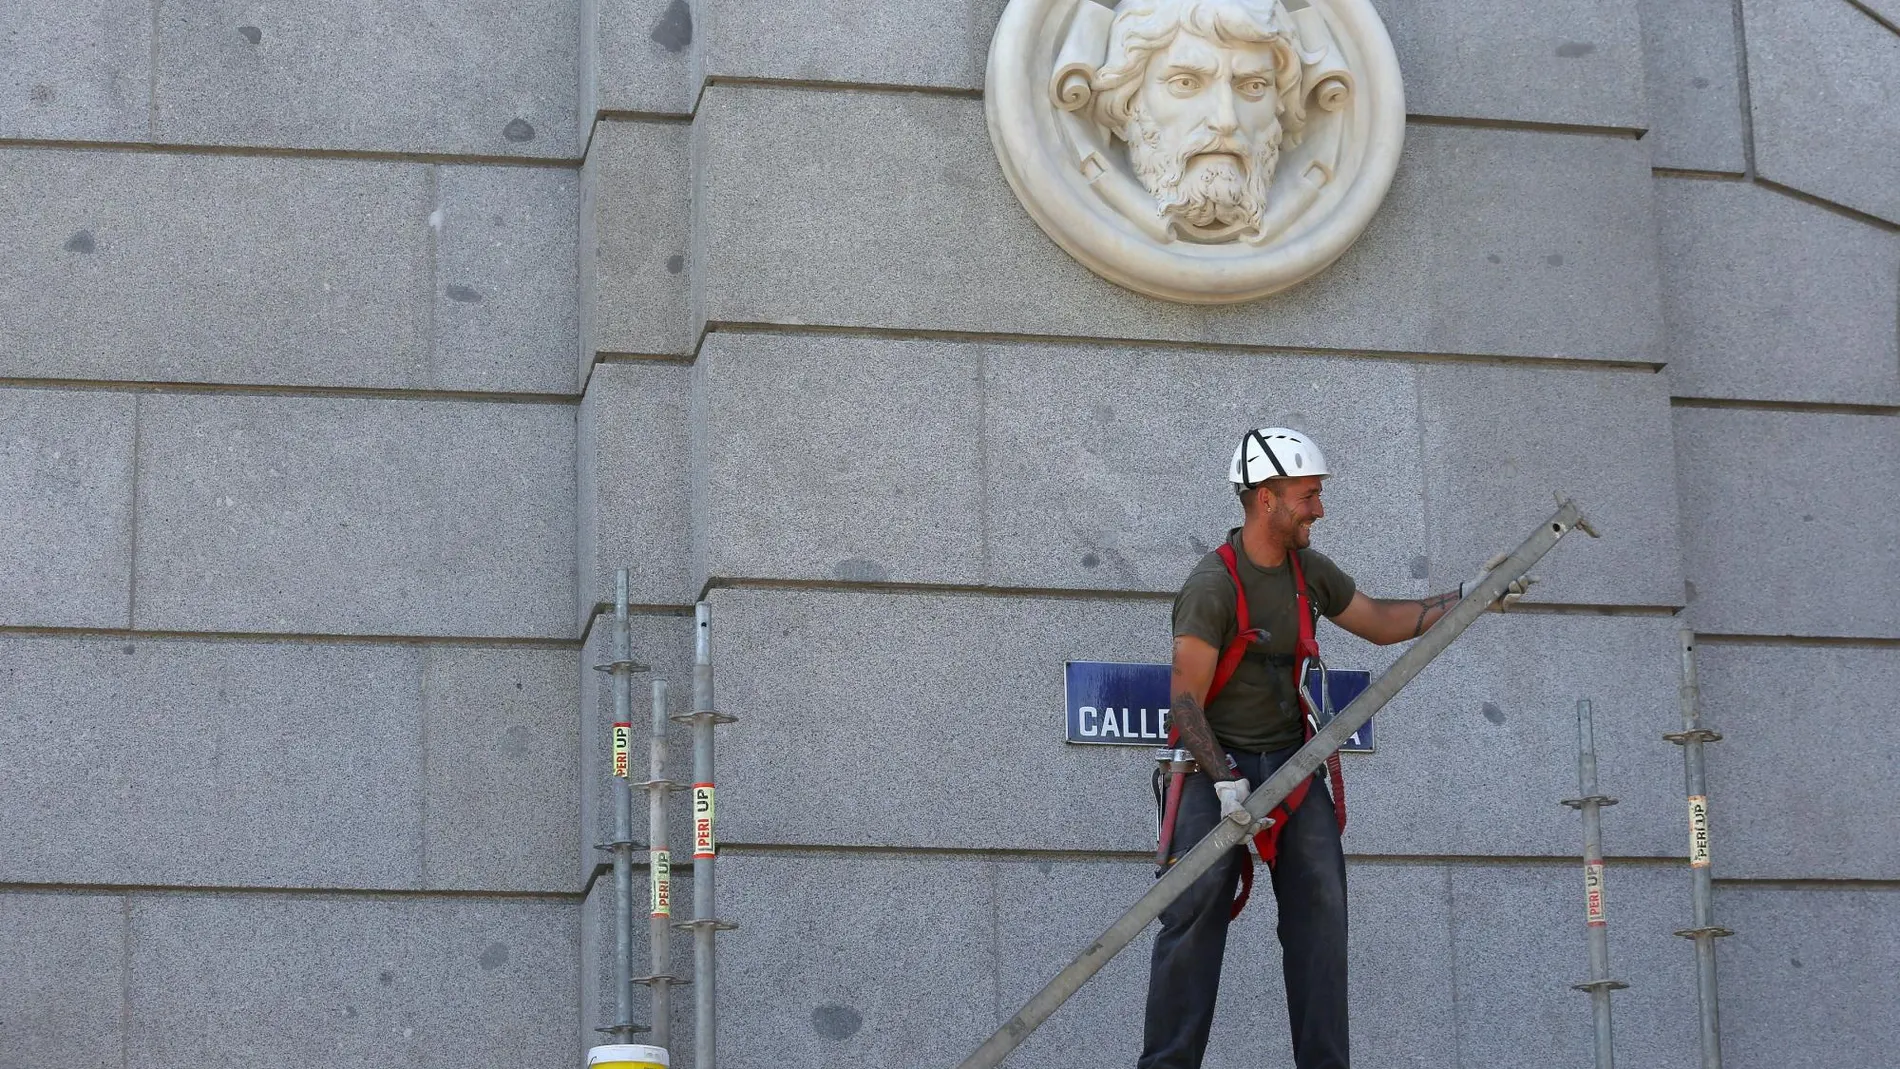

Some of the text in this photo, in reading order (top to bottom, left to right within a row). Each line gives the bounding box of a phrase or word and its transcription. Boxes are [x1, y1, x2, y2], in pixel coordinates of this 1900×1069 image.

[1079, 706, 1171, 739] CALLE
[616, 728, 627, 777] PERI UP
[697, 789, 710, 847] PERI UP
[1694, 804, 1707, 857] PERI UP
[658, 852, 669, 907] PERI UP
[1587, 866, 1600, 916] PERI UP
